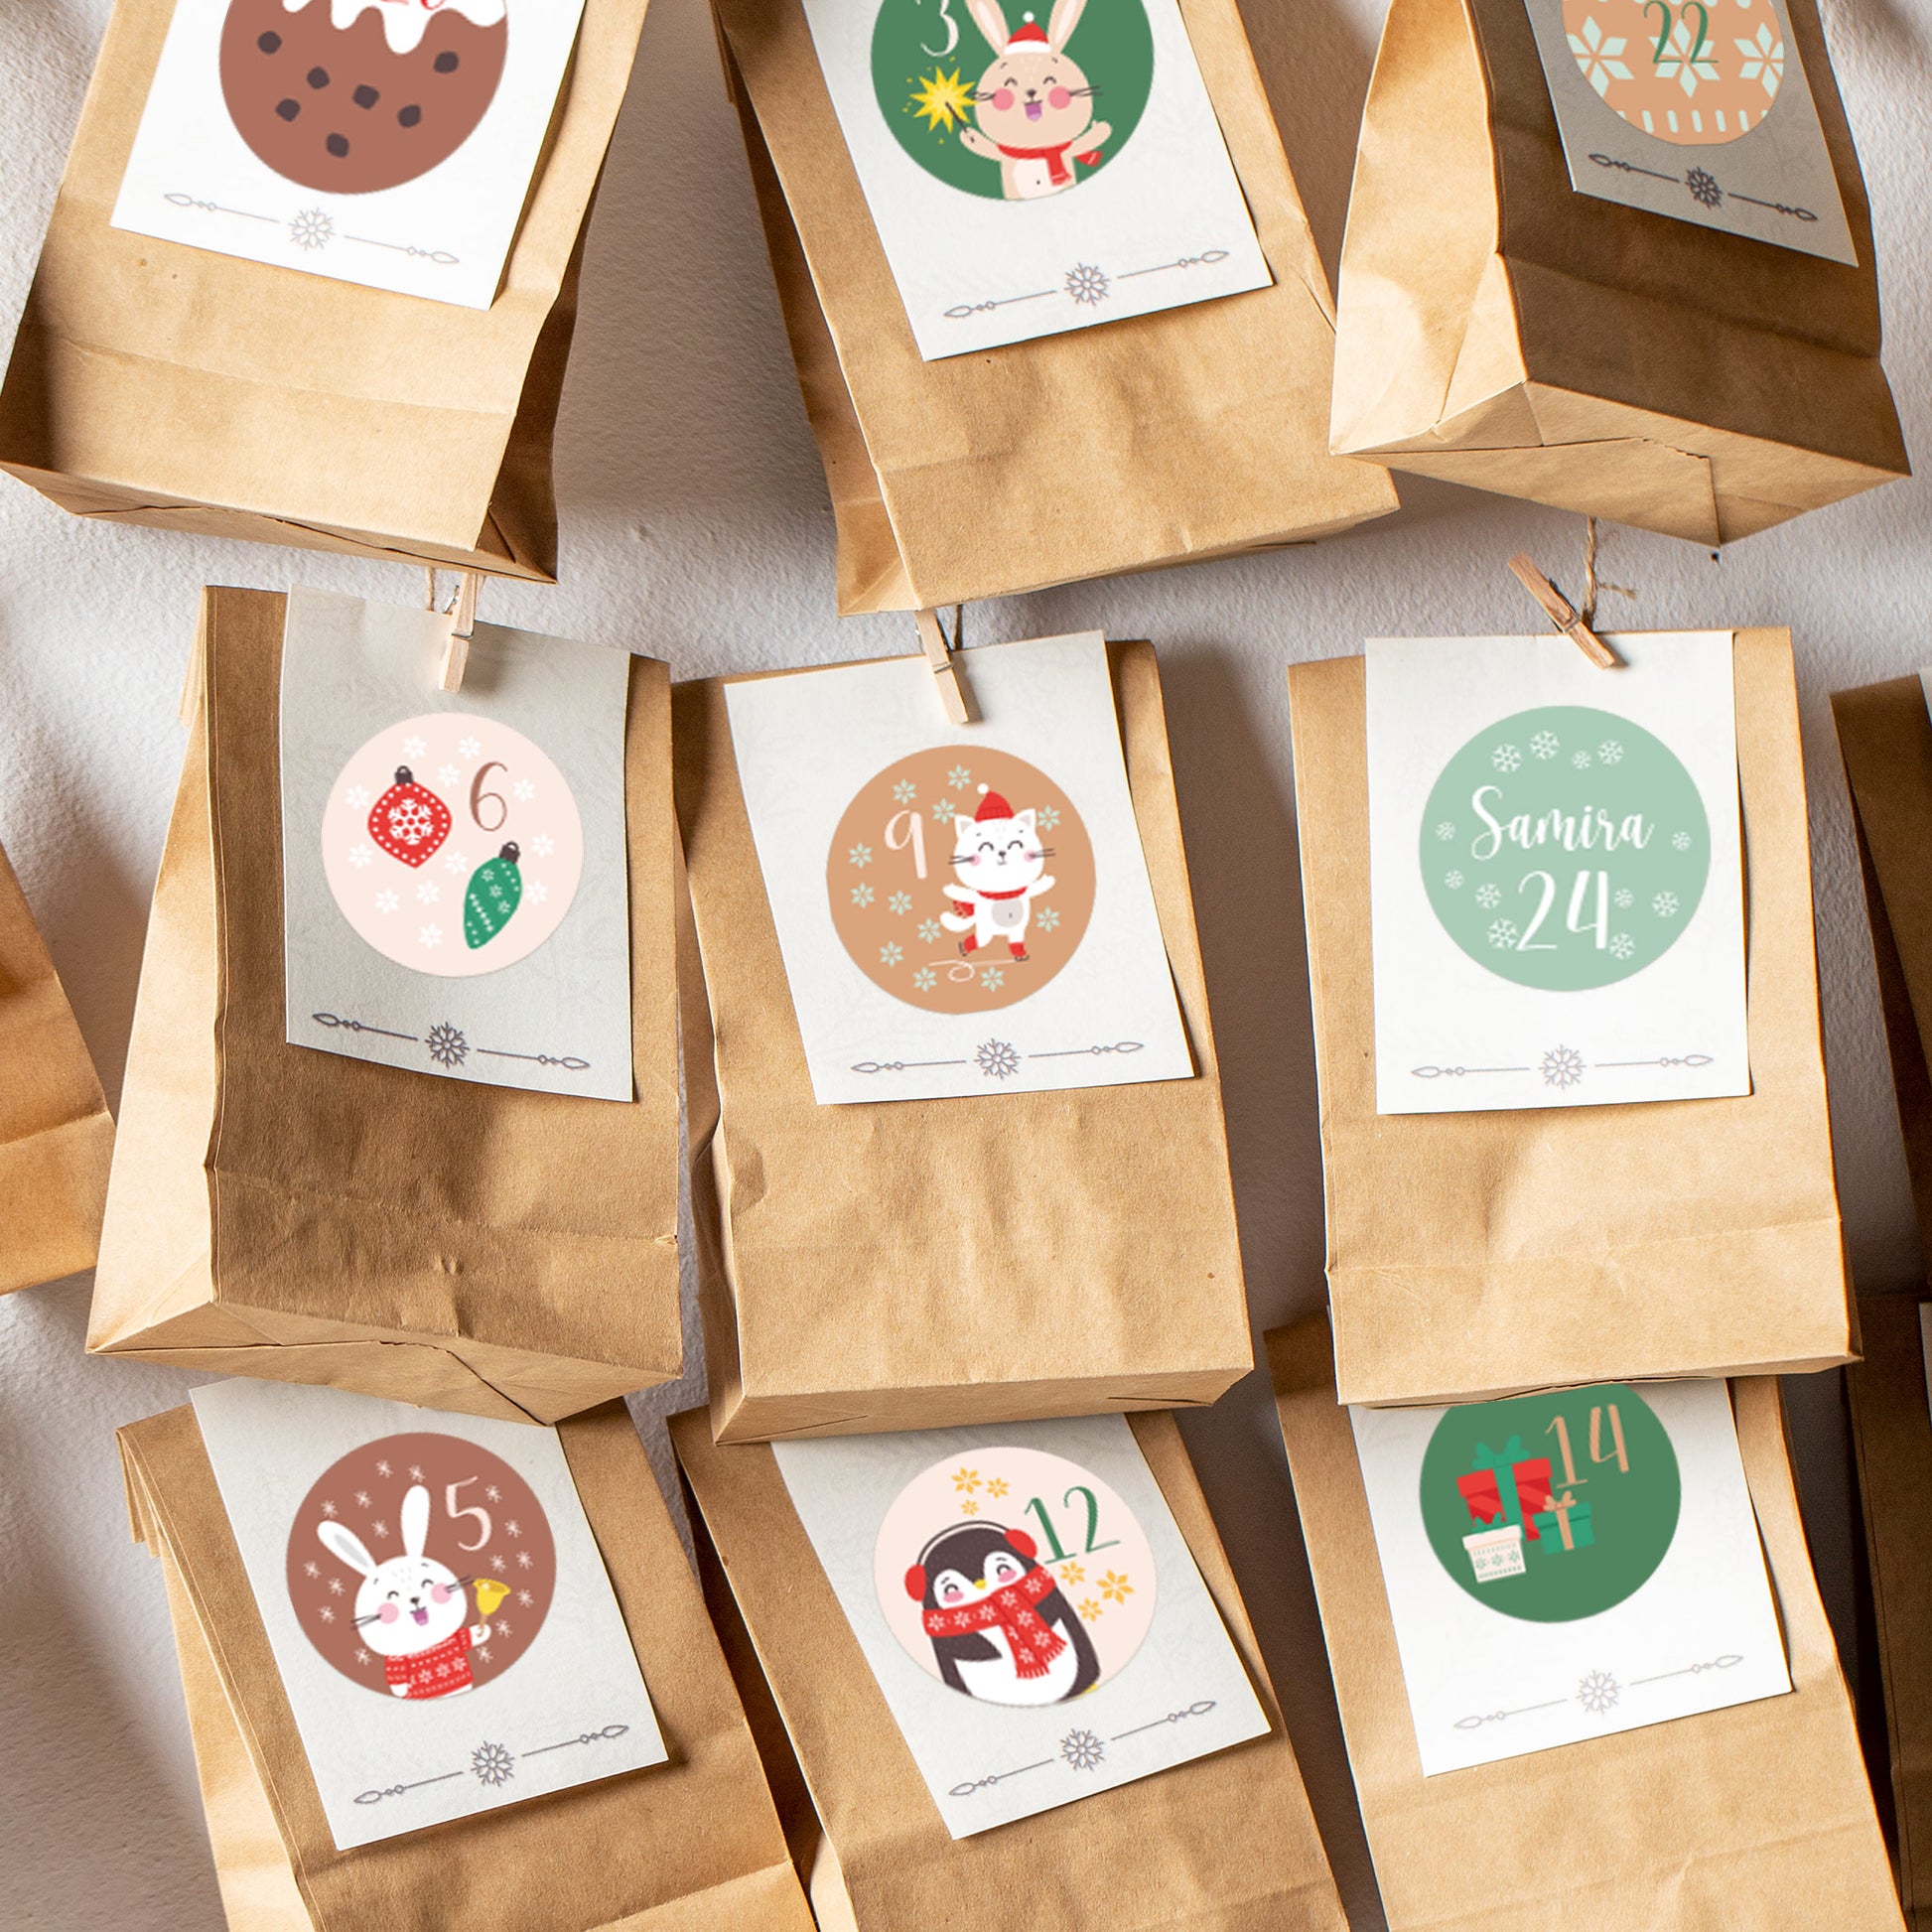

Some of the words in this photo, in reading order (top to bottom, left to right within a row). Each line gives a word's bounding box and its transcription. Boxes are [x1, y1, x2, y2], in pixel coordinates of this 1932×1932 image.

[915, 0, 960, 57] 3
[1643, 0, 1719, 64] 22
[470, 761, 508, 832] 6
[1470, 785, 1655, 861] Samira
[884, 809, 928, 880] 9
[1515, 870, 1608, 951] 24
[1545, 1404, 1630, 1489] 14
[445, 1475, 492, 1552] 5
[1024, 1485, 1121, 1565] 12
